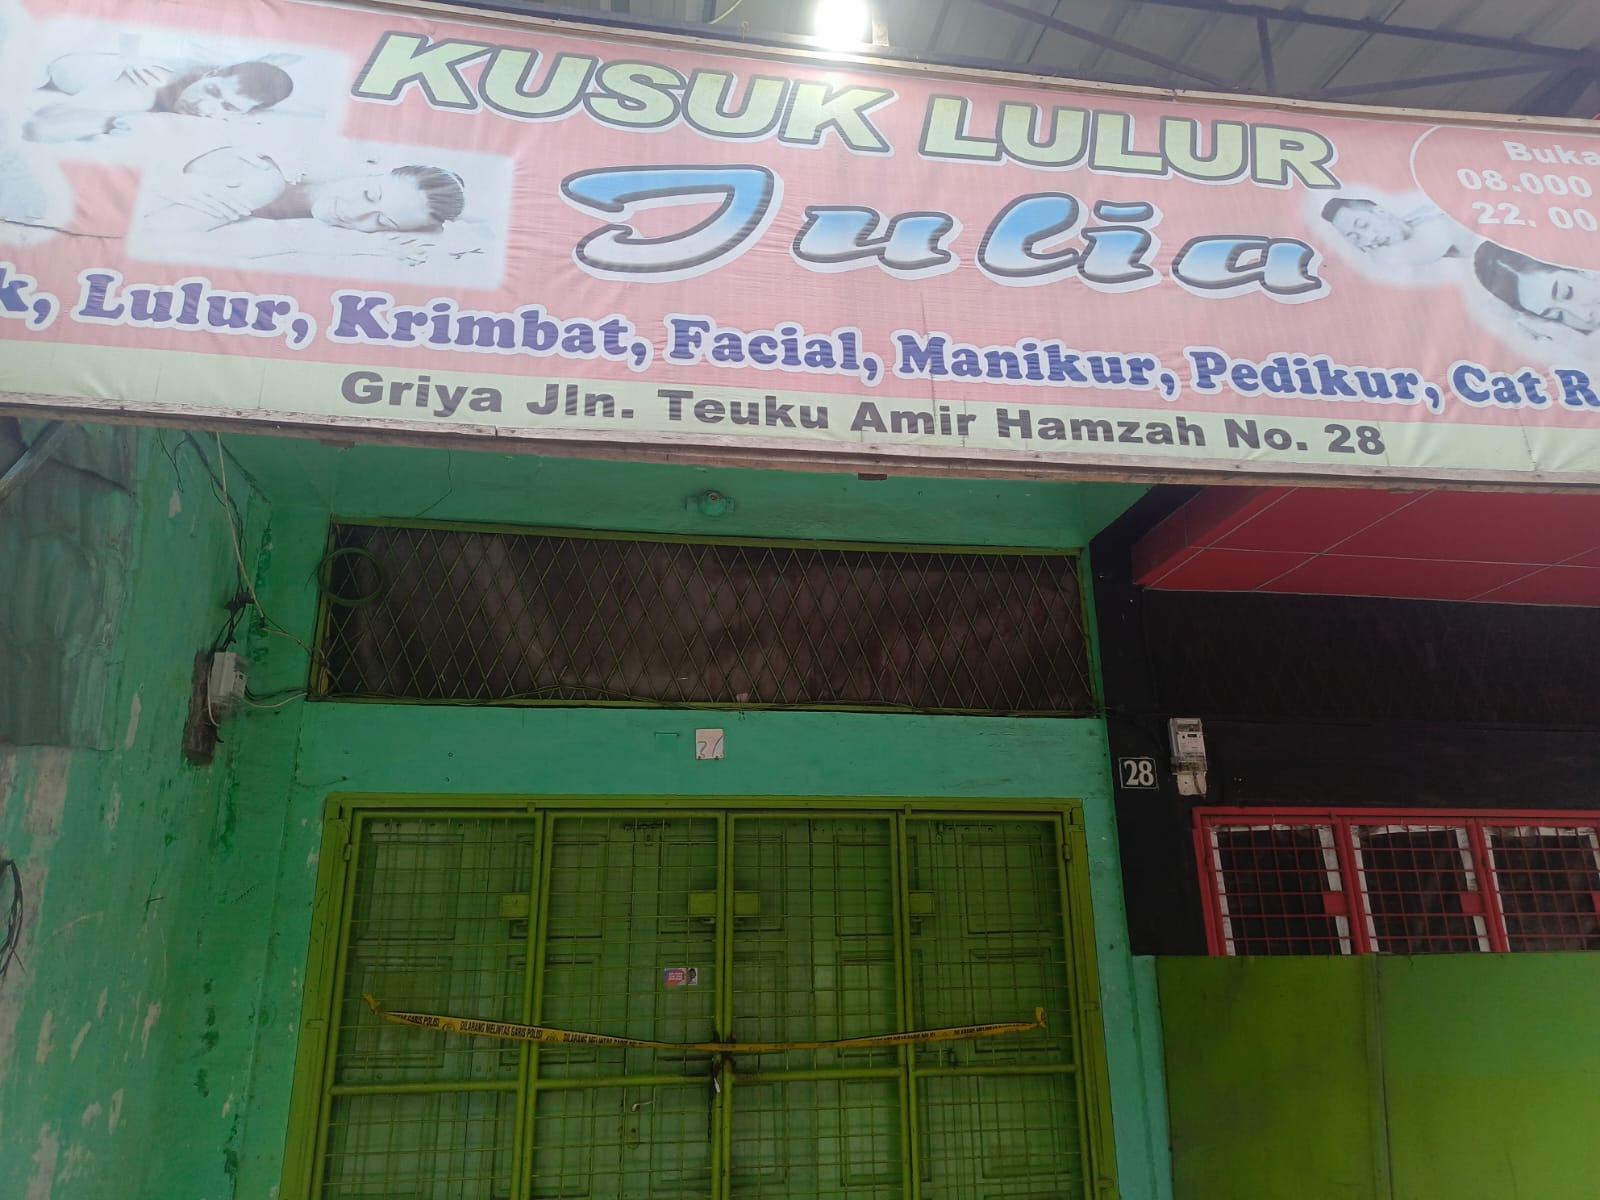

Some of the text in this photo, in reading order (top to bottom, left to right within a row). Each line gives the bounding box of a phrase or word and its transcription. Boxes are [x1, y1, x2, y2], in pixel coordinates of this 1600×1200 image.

[351, 30, 1341, 190] KUSUK LULUR
[1503, 140, 1600, 166] Buka
[1457, 168, 1593, 198] 08.000
[1472, 201, 1599, 232] 22. 00
[557, 164, 1331, 302] Julia
[78, 273, 309, 344] Lulur,
[334, 294, 647, 366] Krimbat,
[669, 318, 878, 381] Facial,
[897, 334, 1175, 396] Manikur,
[1189, 351, 1440, 408] Pedikur,
[1453, 365, 1547, 404] Cat
[341, 371, 1385, 455] Griya Jln. Teuku Amir Hamzah No. 28
[1124, 760, 1154, 786] 28
[460, 1020, 486, 1033] DILARANG
